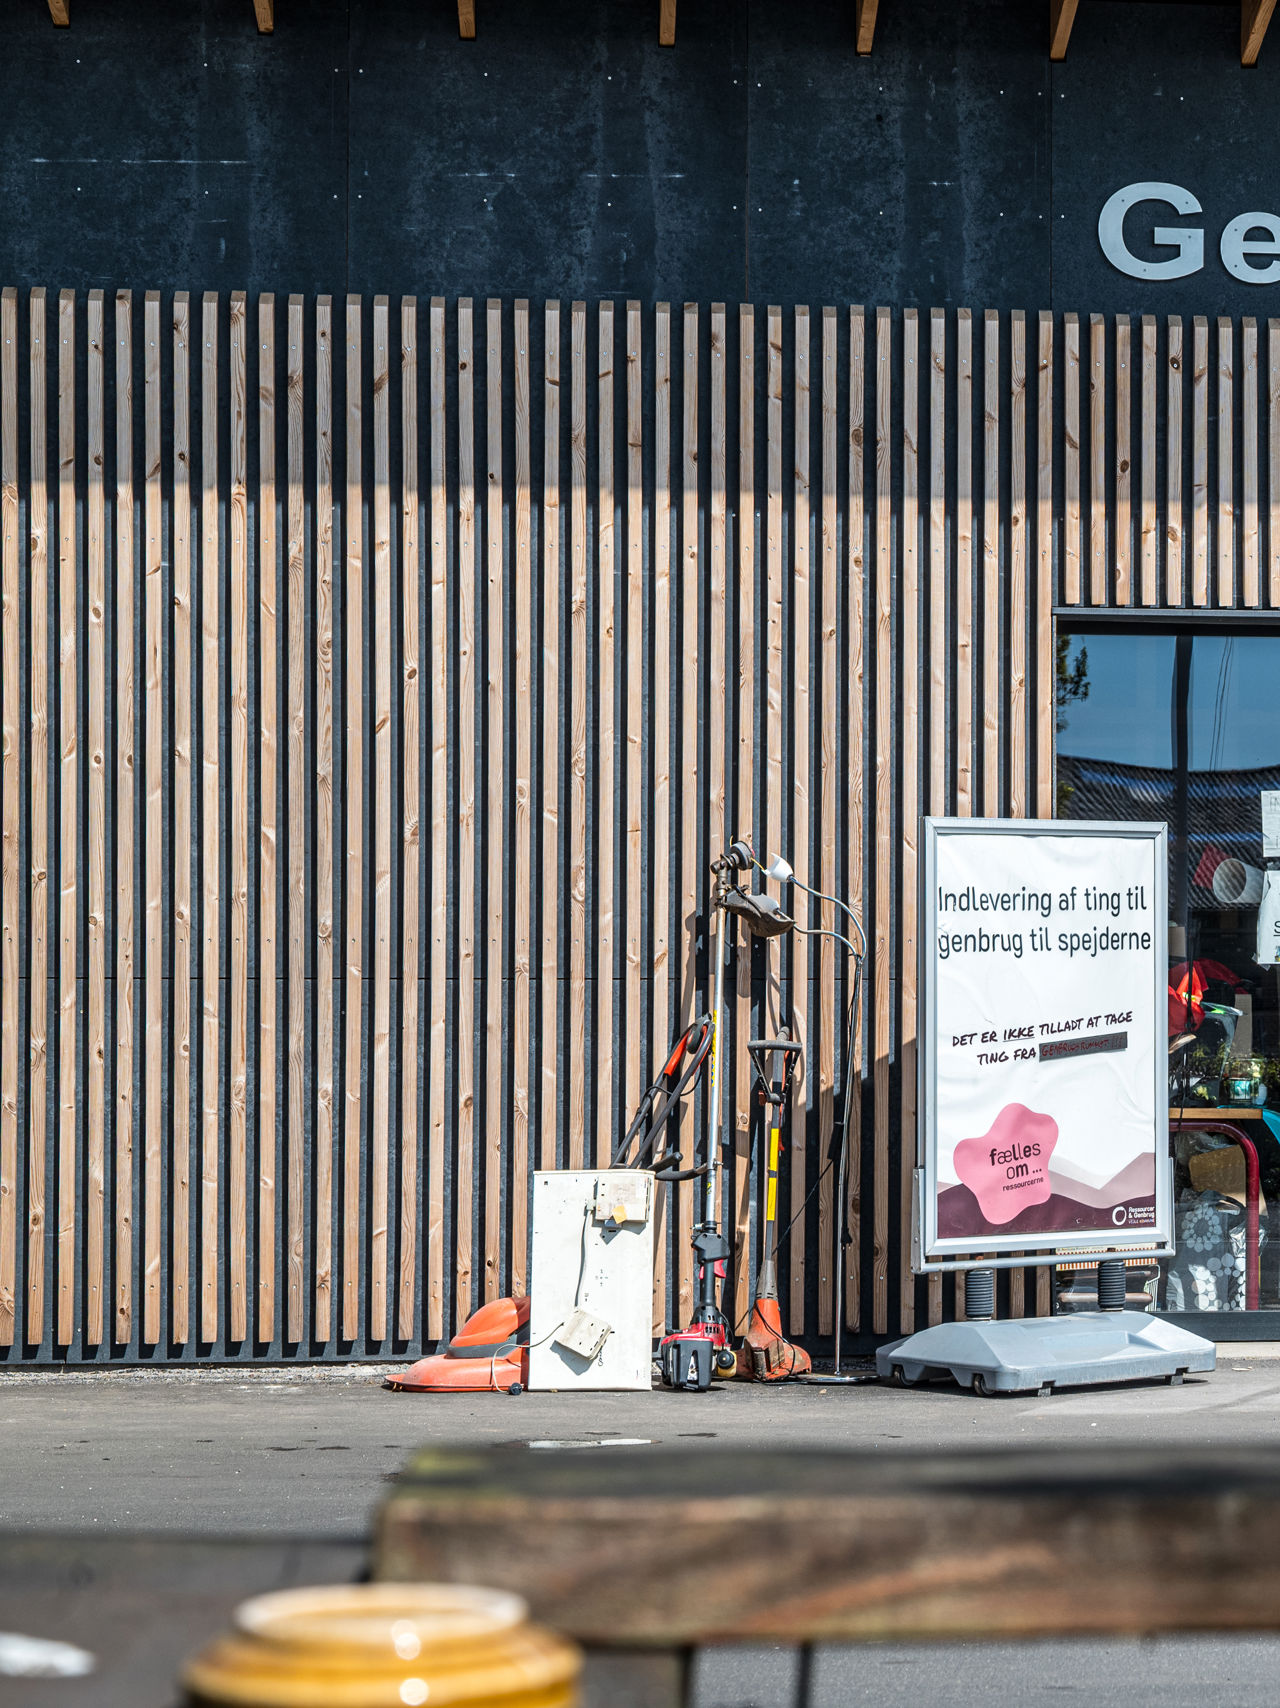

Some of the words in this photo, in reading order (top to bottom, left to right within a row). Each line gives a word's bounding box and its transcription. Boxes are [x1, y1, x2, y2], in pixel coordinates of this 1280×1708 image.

[938, 886, 1052, 917] Indlevering
[1058, 886, 1078, 912] af
[1084, 886, 1121, 917] ting
[1126, 885, 1148, 911] til
[938, 927, 1023, 959] genbrug
[1029, 926, 1052, 952] til
[1058, 926, 1152, 957] spejderne
[952, 1032, 978, 1048] DET
[980, 1030, 998, 1043] ER
[1002, 1025, 1036, 1042] IKKE
[1038, 1018, 1085, 1036] TILLADT
[1086, 1015, 1102, 1030] AT
[1103, 1011, 1134, 1026] TAGE
[976, 1050, 1010, 1066] TING
[1013, 1048, 1037, 1062] FRA
[989, 1142, 1042, 1167] fælles
[1006, 1163, 1029, 1180] om
[1002, 1177, 1044, 1192] ressourcerne
[1134, 1211, 1155, 1219] Genbrug
